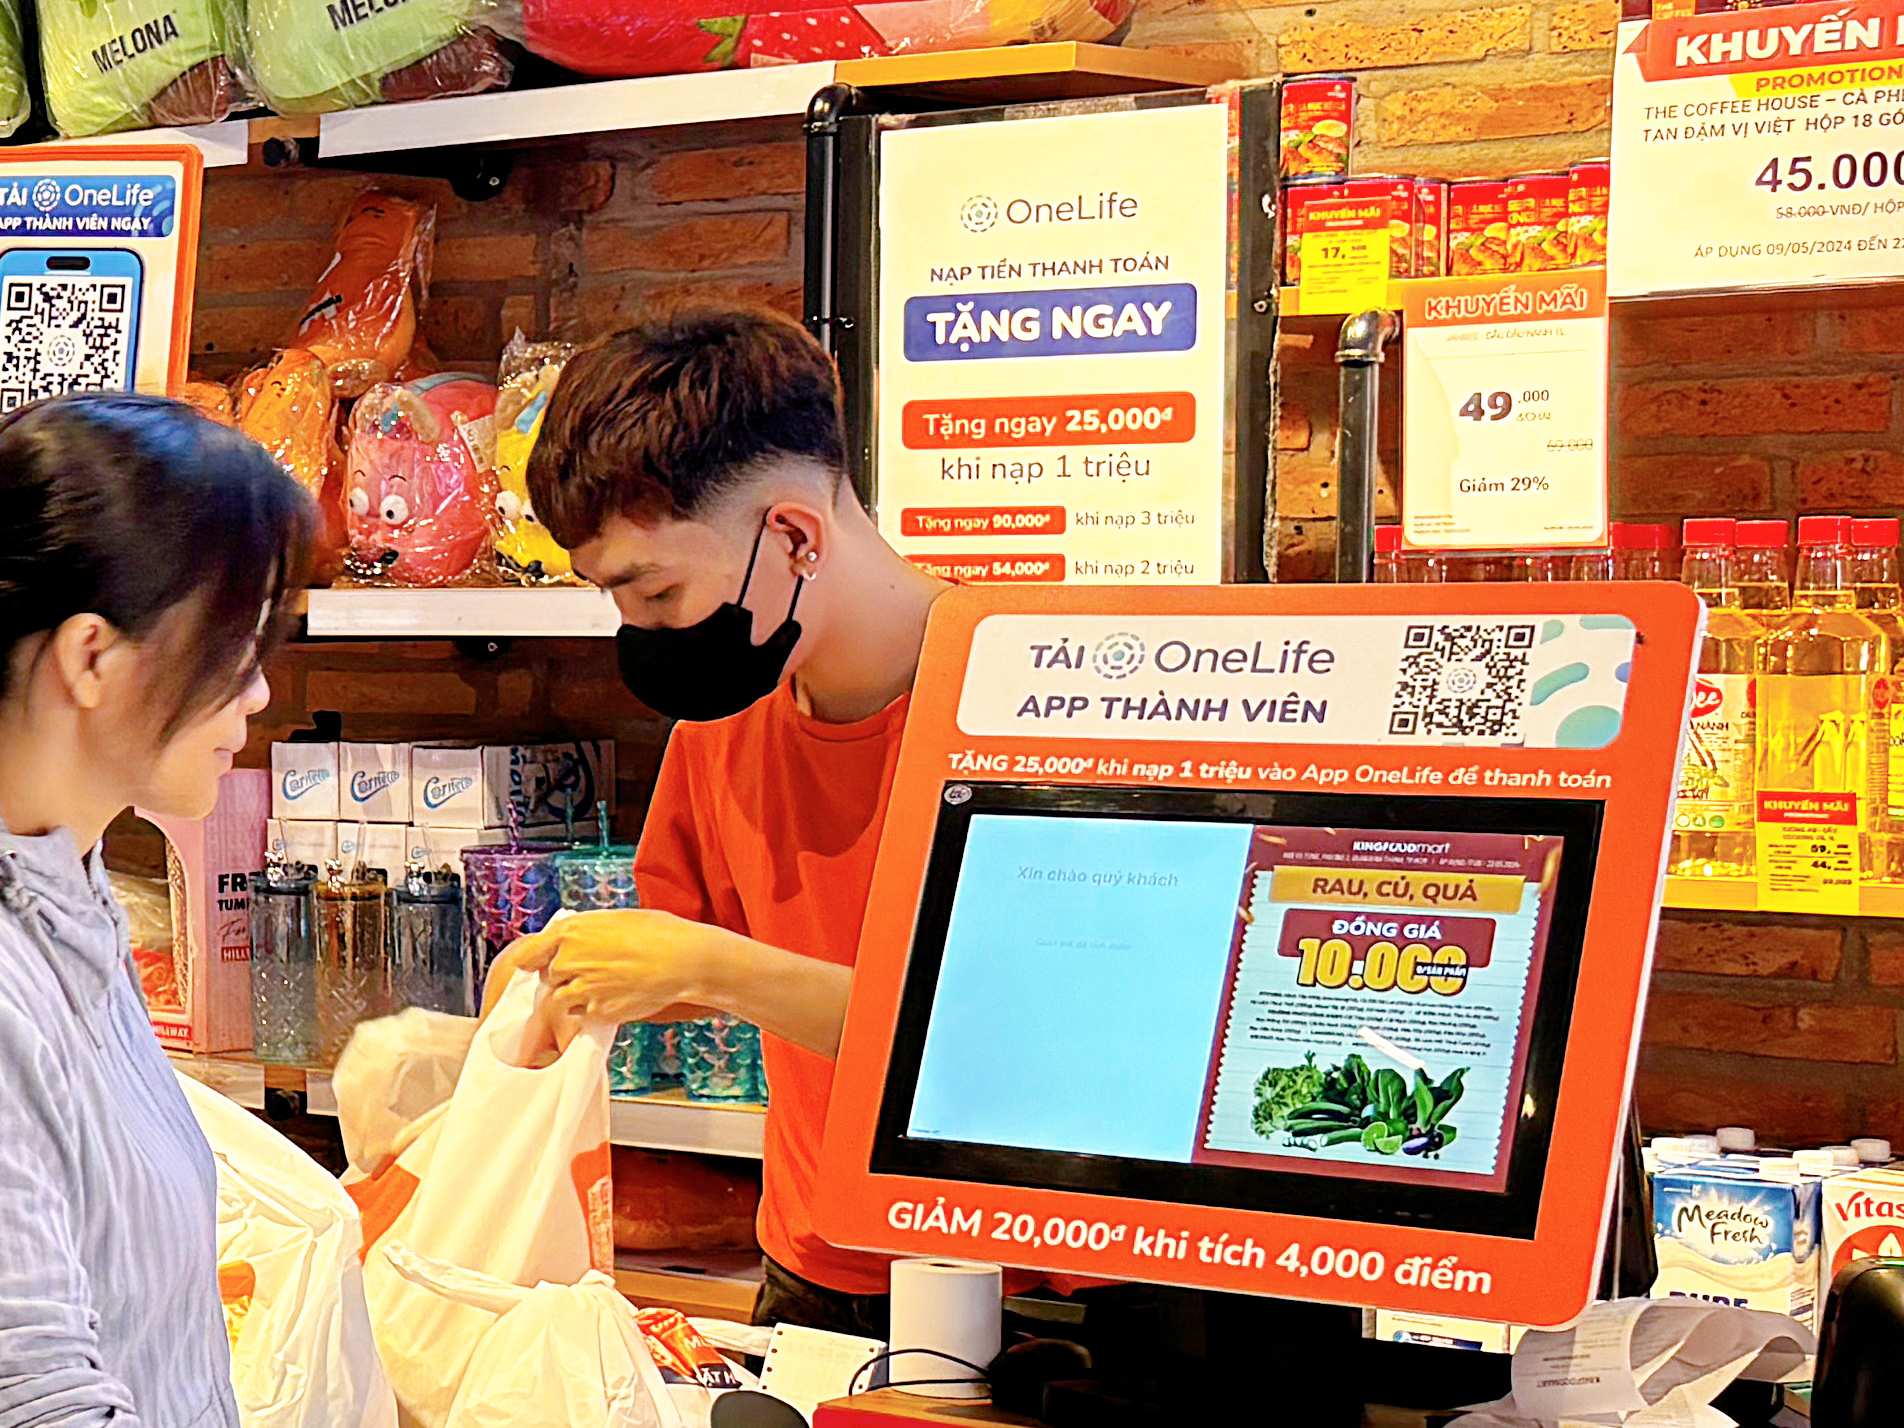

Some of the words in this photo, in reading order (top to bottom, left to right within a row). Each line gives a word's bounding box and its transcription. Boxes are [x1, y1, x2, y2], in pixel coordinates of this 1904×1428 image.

[92, 17, 181, 75] MELONA
[1675, 7, 1881, 67] KHUYẾN
[1644, 106, 1678, 120] THE
[1683, 101, 1751, 116] COFFEE
[1758, 95, 1820, 111] HOUSE
[1842, 92, 1868, 106] CÀ
[1643, 127, 1678, 142] TAN
[1732, 123, 1748, 138] VỊ
[1754, 118, 1795, 136] VIỆT
[1805, 116, 1845, 133] HỘP
[1852, 114, 1872, 127] 18
[65, 184, 153, 206] OneLife
[1006, 192, 1139, 225] OneLife
[25, 214, 73, 230] THÀNH
[75, 214, 108, 230] VIÊN
[111, 217, 152, 230] NGAY
[1766, 240, 1852, 256] 09/05/2024
[1857, 234, 1888, 251] ĐẾN
[930, 265, 971, 285] NẠP
[1028, 260, 1103, 278] THANH
[1109, 253, 1169, 274] TOÁN
[1426, 286, 1531, 319] KHUYẾN
[1538, 284, 1586, 312] MÃI
[927, 302, 1041, 351] TẶNG
[1051, 301, 1173, 340] NGAY
[1459, 391, 1512, 421] 49
[923, 413, 986, 439] Tặng
[994, 413, 1057, 437] ngay
[1065, 407, 1174, 433] 25,000đ
[941, 457, 980, 480] khi
[992, 459, 1044, 484] nạp
[1057, 455, 1070, 478] 1
[1082, 453, 1151, 483] triệu
[1459, 478, 1504, 492] Giảm
[1511, 477, 1549, 491] 29%
[1076, 512, 1099, 526] khi
[1104, 513, 1137, 530] nạp
[1141, 511, 1151, 526] 3
[1157, 511, 1195, 528] triệu
[1029, 643, 1085, 669] TẢI
[1154, 639, 1335, 675] OneLife
[1016, 696, 1088, 718] APP
[1101, 695, 1228, 722] THÀNH
[1243, 692, 1327, 723] VIÊN
[948, 753, 1008, 773] TẶNG
[1096, 759, 1129, 777] khi
[1133, 761, 1175, 783] nạp
[1181, 761, 1194, 778] 1
[1198, 761, 1253, 782] triệu
[1258, 763, 1296, 781] vào
[1302, 765, 1350, 787] App
[1354, 765, 1444, 783] OneLife
[1448, 763, 1479, 785] để
[1483, 767, 1553, 787] thanh
[1558, 768, 1611, 789] toán
[1017, 866, 1043, 880] Xin
[1047, 867, 1086, 882] chào
[1092, 870, 1123, 887] quý
[1127, 872, 1178, 887] khách
[1312, 877, 1368, 899] RAU,
[1376, 876, 1414, 901] CỦ,
[1422, 879, 1477, 901] QUẢ
[1332, 916, 1397, 937] ĐỒNG
[1404, 920, 1442, 939] GIÁ
[1677, 1200, 1769, 1238] Meadow
[1710, 1221, 1764, 1245] Fresh
[888, 1198, 981, 1237] GIẢM
[1134, 1226, 1186, 1260] khi
[1198, 1232, 1264, 1268] tích
[1276, 1244, 1384, 1281] 4,000
[1394, 1256, 1492, 1294] điểm
